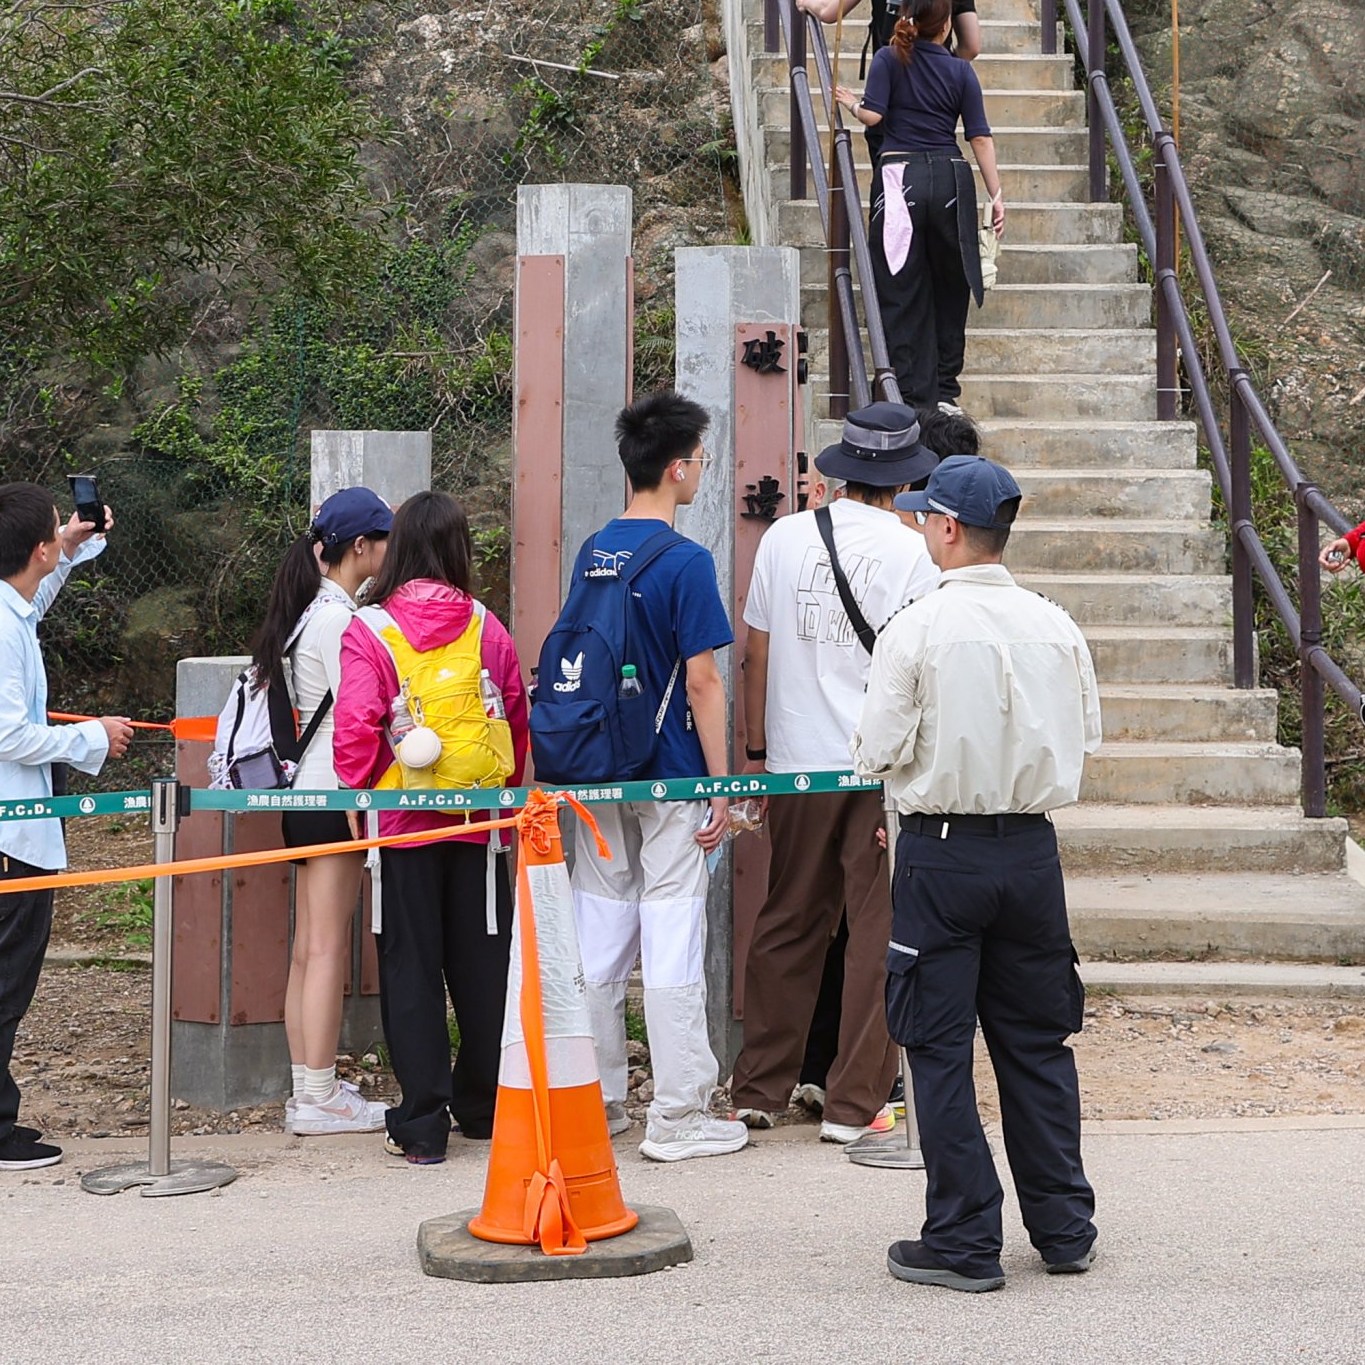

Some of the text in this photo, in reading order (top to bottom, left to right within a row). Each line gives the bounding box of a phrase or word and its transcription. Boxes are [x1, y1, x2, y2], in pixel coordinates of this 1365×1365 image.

[246, 794, 327, 808] 漁農自然護理署
[675, 1129, 706, 1141] HOKA
